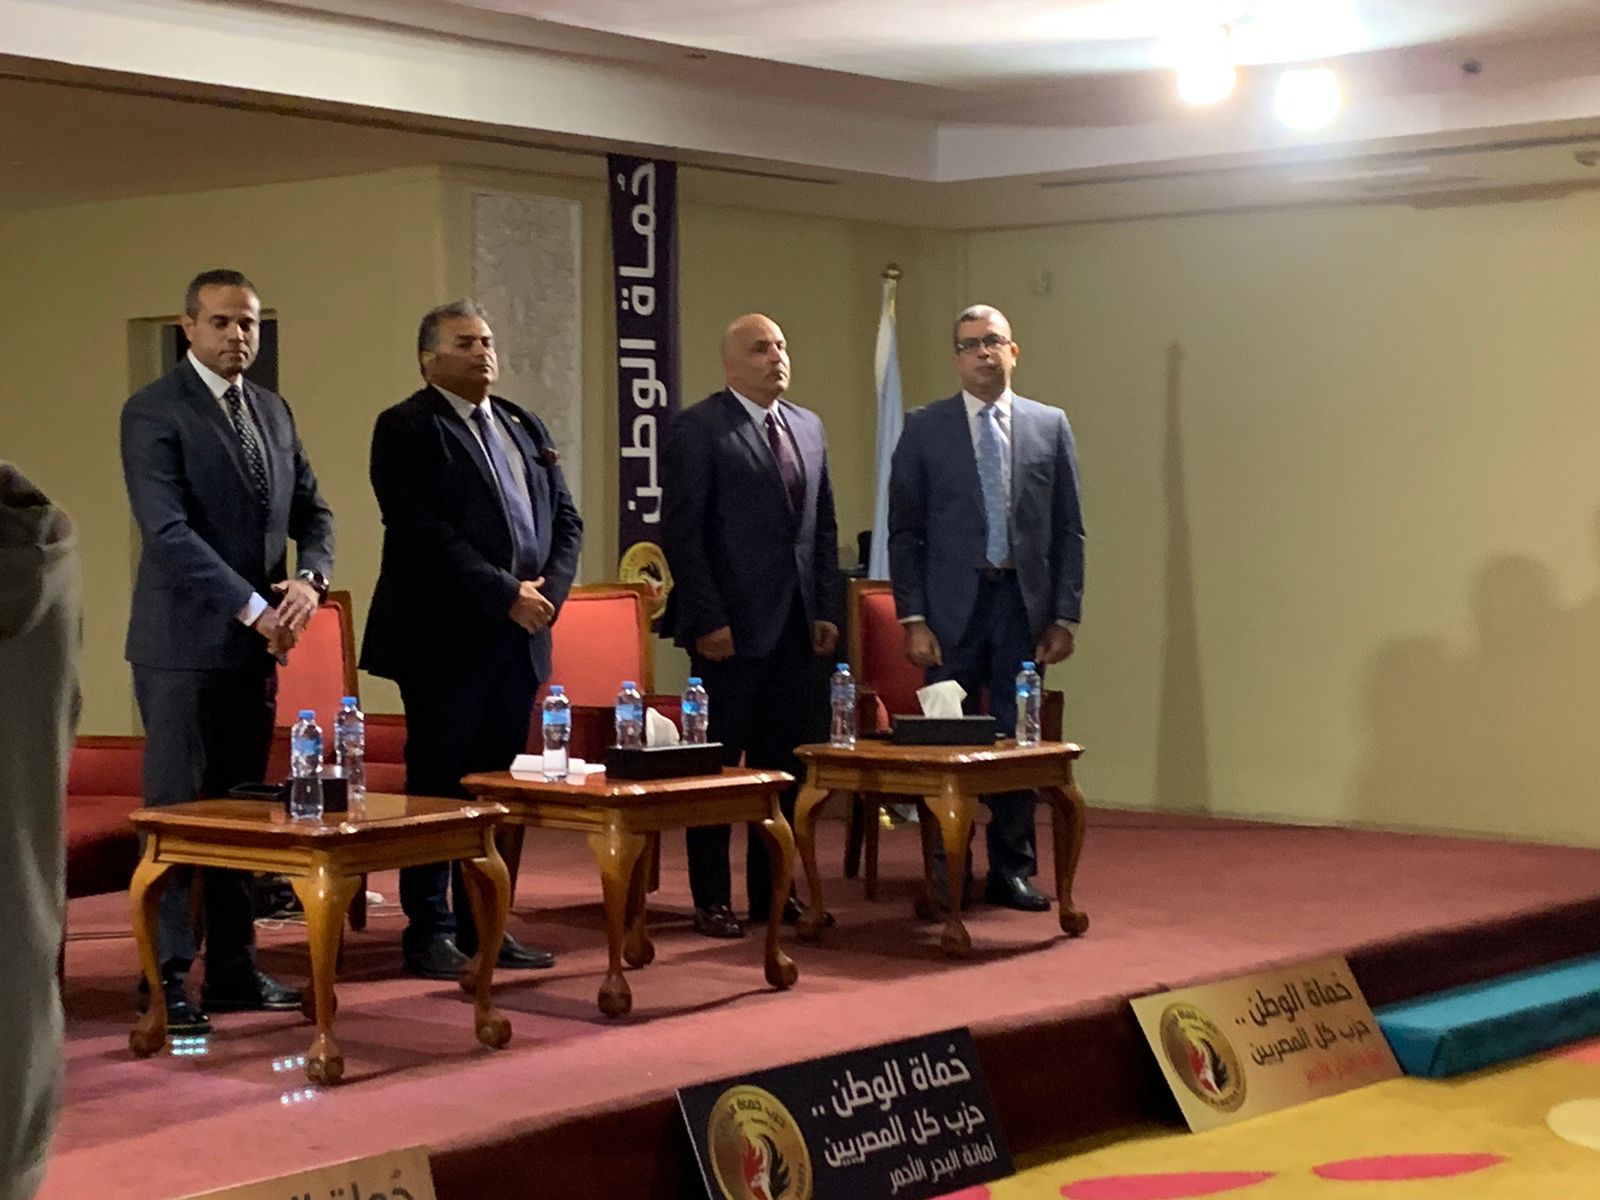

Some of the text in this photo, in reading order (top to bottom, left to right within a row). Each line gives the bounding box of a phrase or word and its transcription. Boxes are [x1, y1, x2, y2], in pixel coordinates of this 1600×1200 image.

[619, 338, 668, 523] الوطن
[1248, 982, 1305, 1027] الوطن
[1249, 1027, 1313, 1066] المصريين
[1314, 1022, 1337, 1050] كل
[831, 1059, 907, 1118] الوطن
[824, 1102, 986, 1168] حزب كل المصريين
[889, 1133, 998, 1195] أمانة البحر الأحمر
